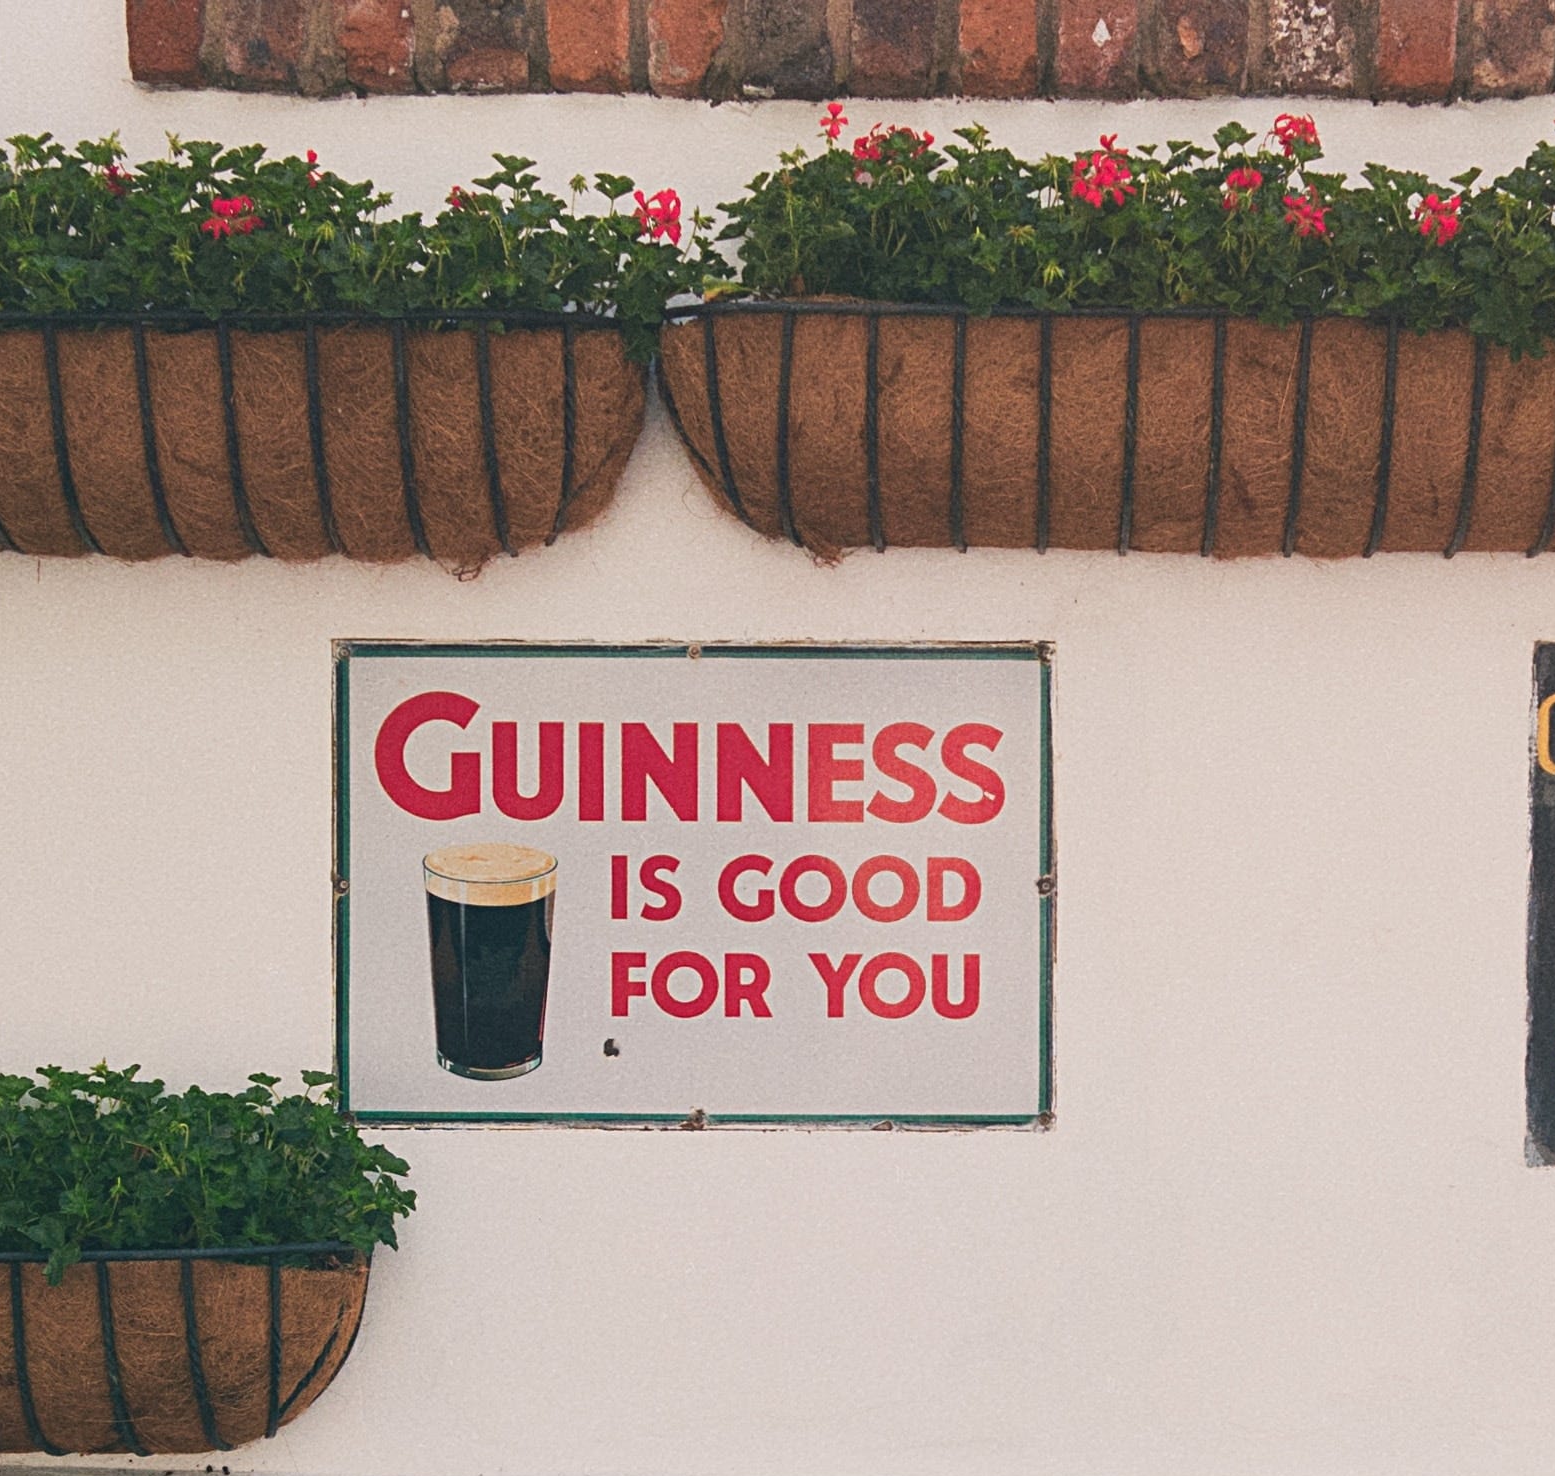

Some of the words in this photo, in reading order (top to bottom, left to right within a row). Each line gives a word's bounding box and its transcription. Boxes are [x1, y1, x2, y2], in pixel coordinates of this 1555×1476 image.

[374, 690, 1005, 824] GUINNESS
[610, 853, 683, 922] IS
[717, 853, 983, 923] GOOD
[610, 950, 773, 1019] FOR
[807, 951, 981, 1020] YOU
